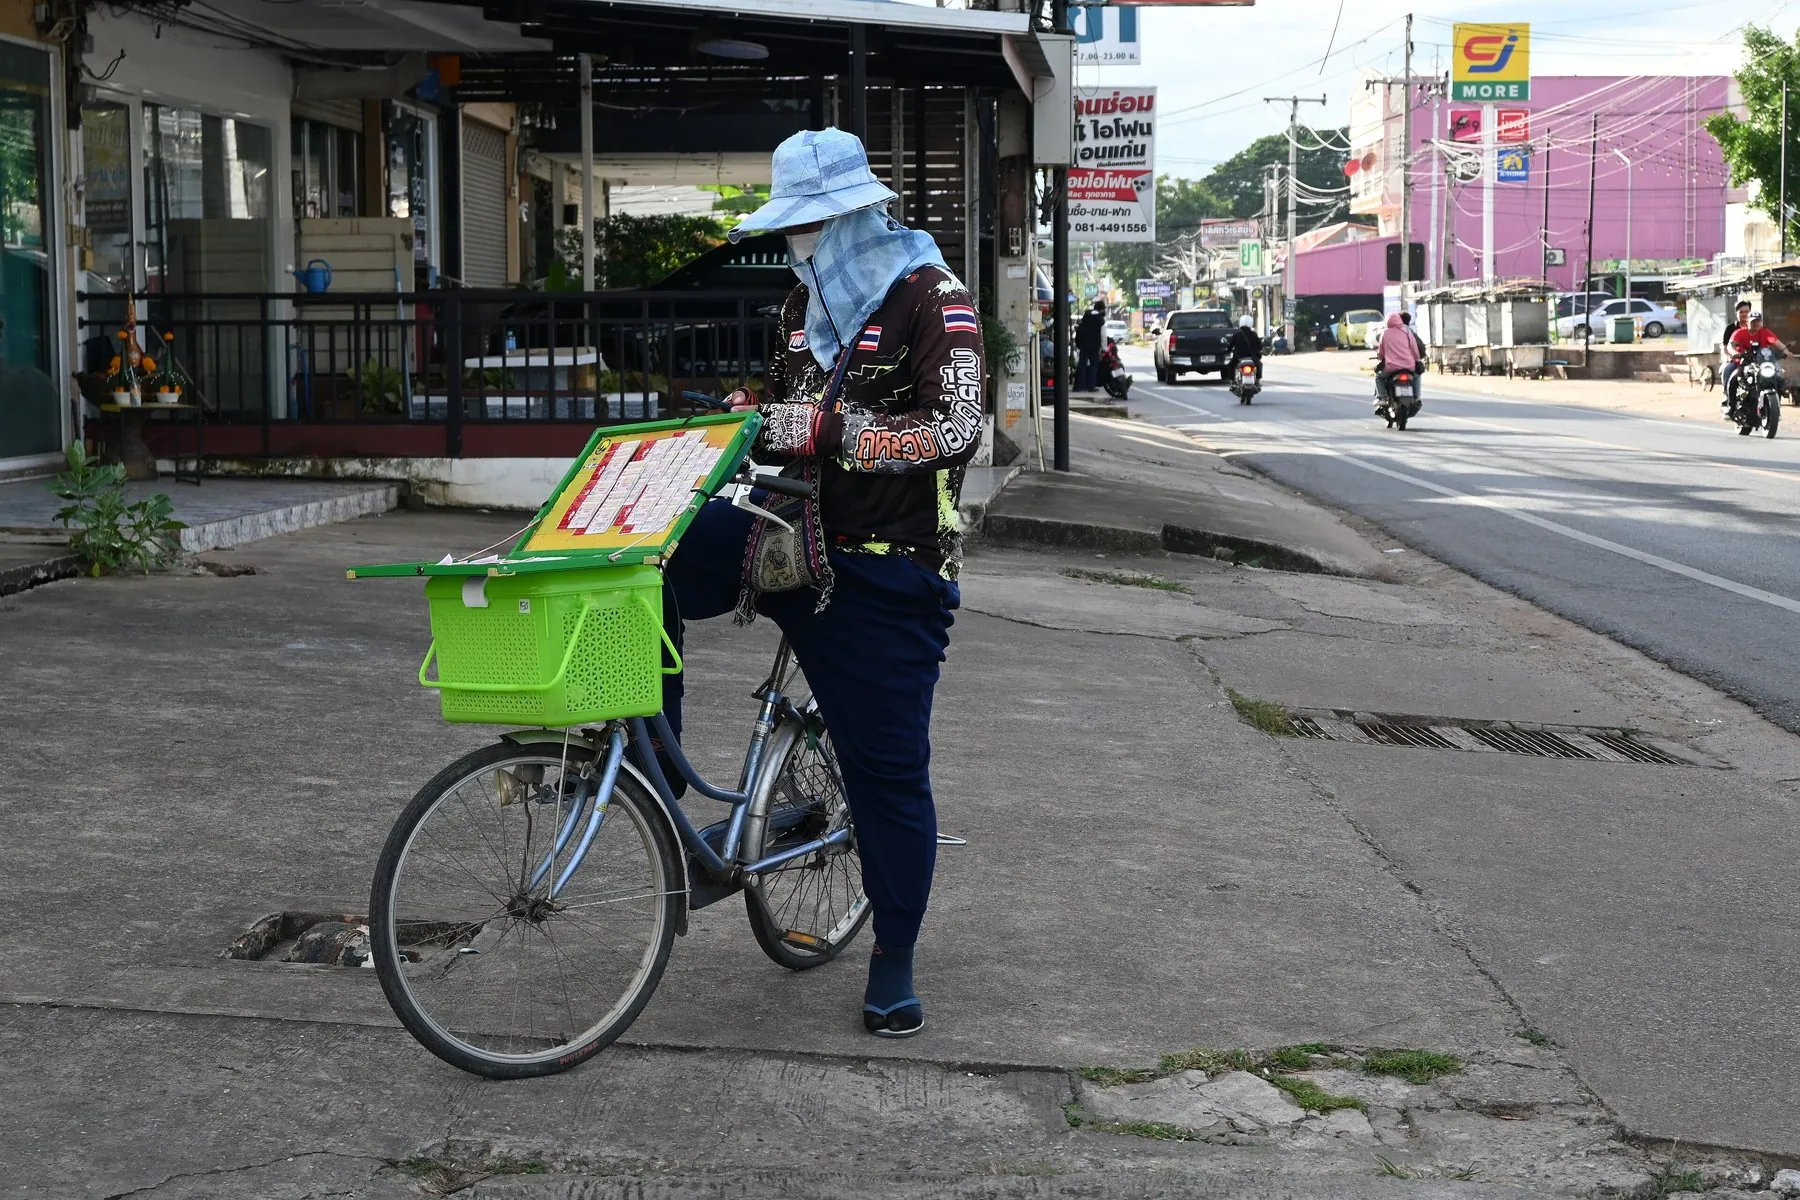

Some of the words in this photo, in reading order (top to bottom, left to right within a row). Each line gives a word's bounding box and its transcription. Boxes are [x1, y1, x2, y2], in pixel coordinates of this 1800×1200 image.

[1462, 85, 1519, 97] MORE
[1090, 118, 1153, 140] ไอโฟน
[1075, 223, 1147, 233] 081-4491556
[1241, 243, 1260, 267] ยา
